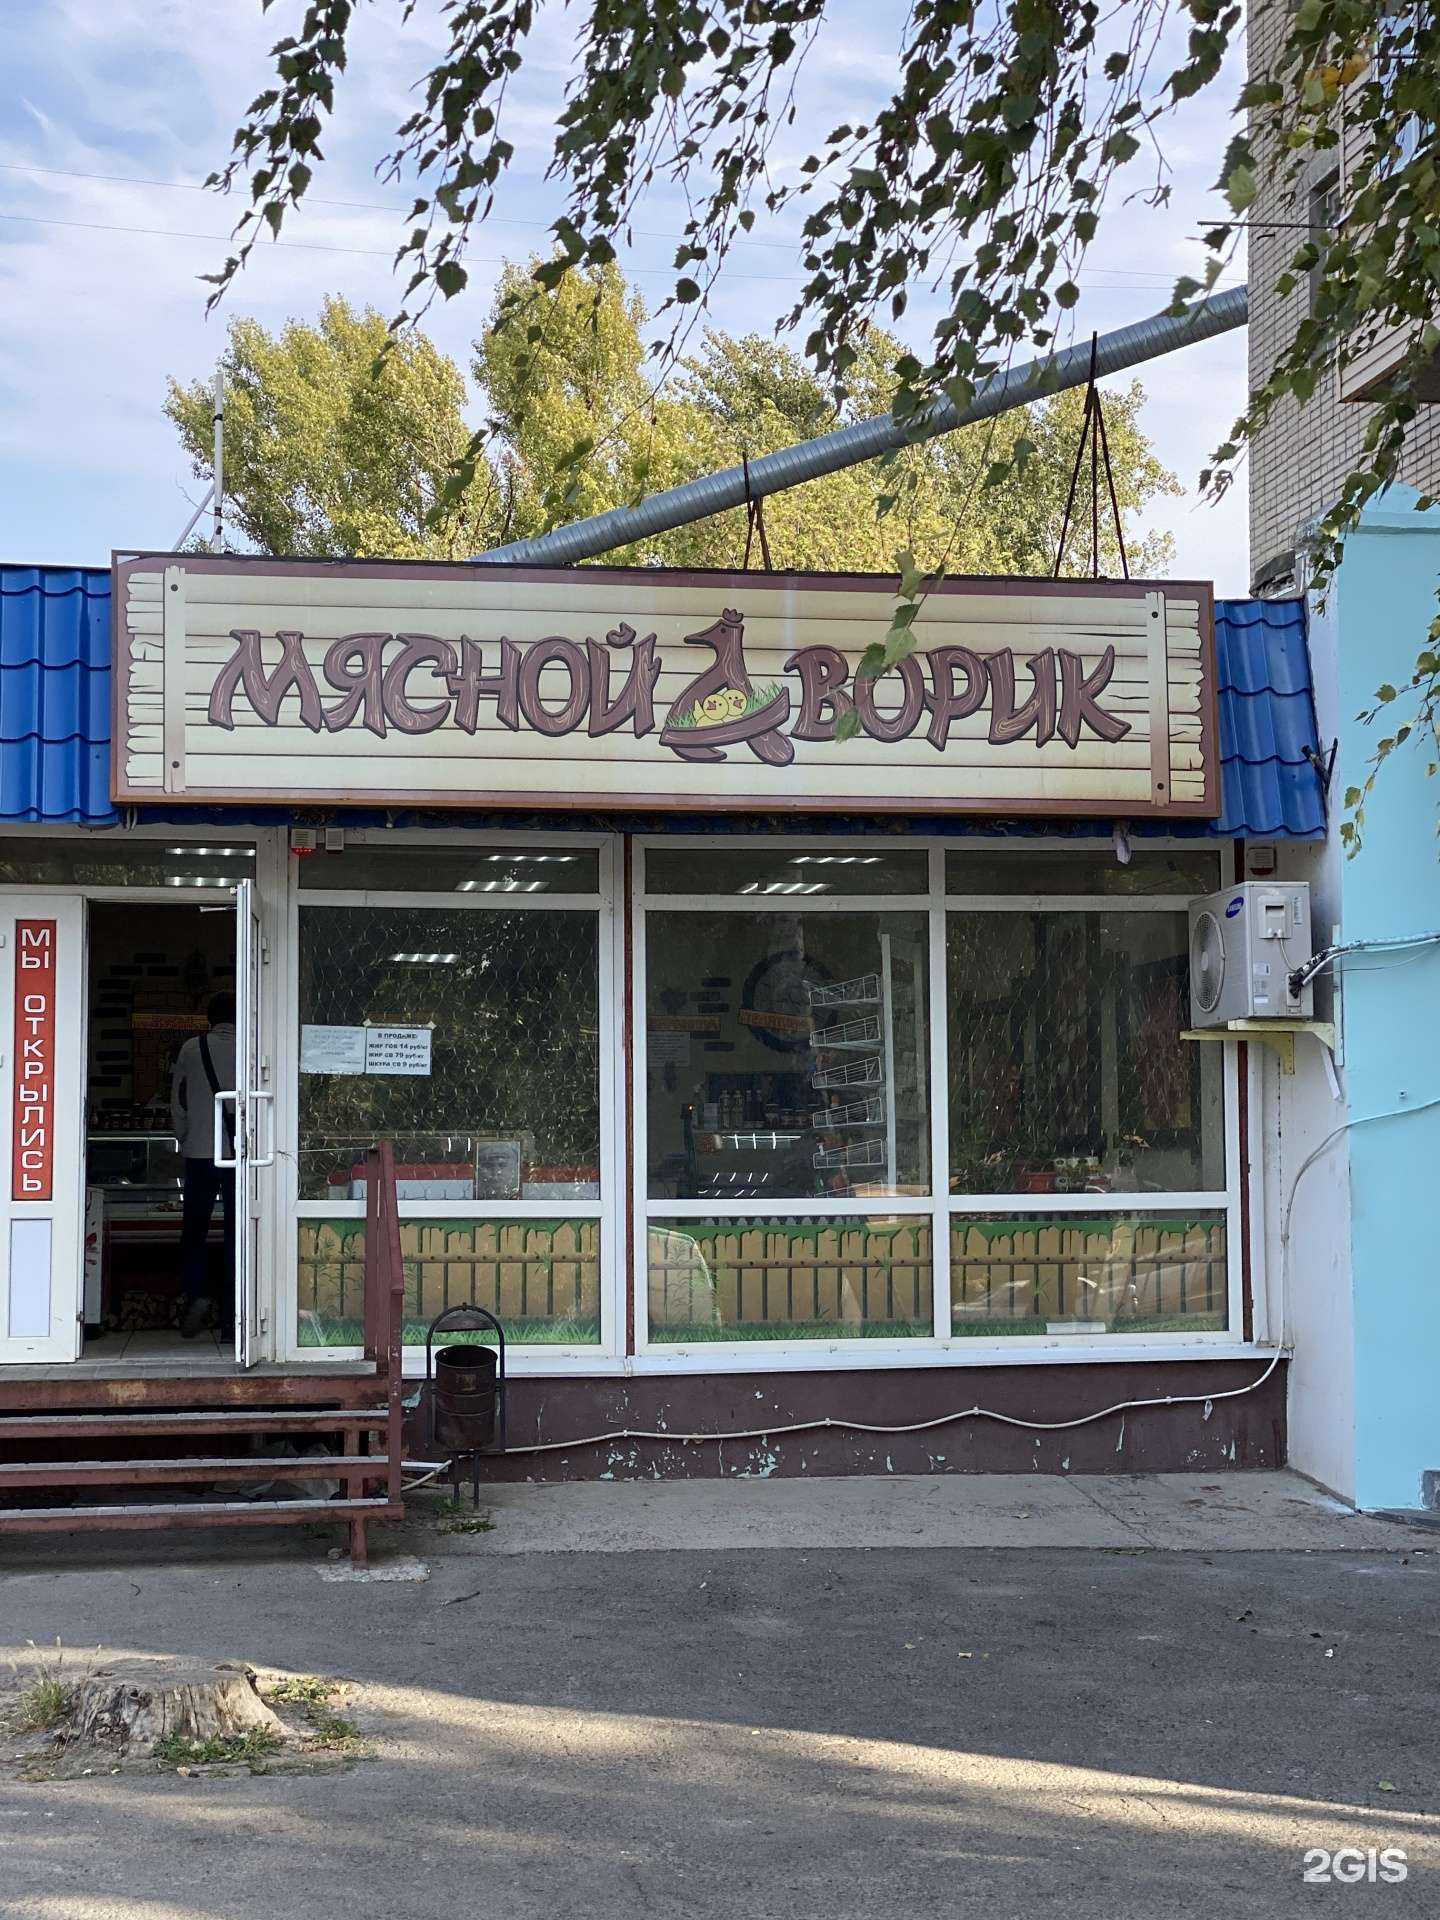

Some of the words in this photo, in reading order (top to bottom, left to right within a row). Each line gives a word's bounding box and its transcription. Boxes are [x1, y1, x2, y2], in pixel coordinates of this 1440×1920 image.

[208, 622, 661, 739] МЯСНОЙ
[20, 928, 50, 969] МЫ
[19, 994, 48, 1192] ОТКРЫЛИСЬ
